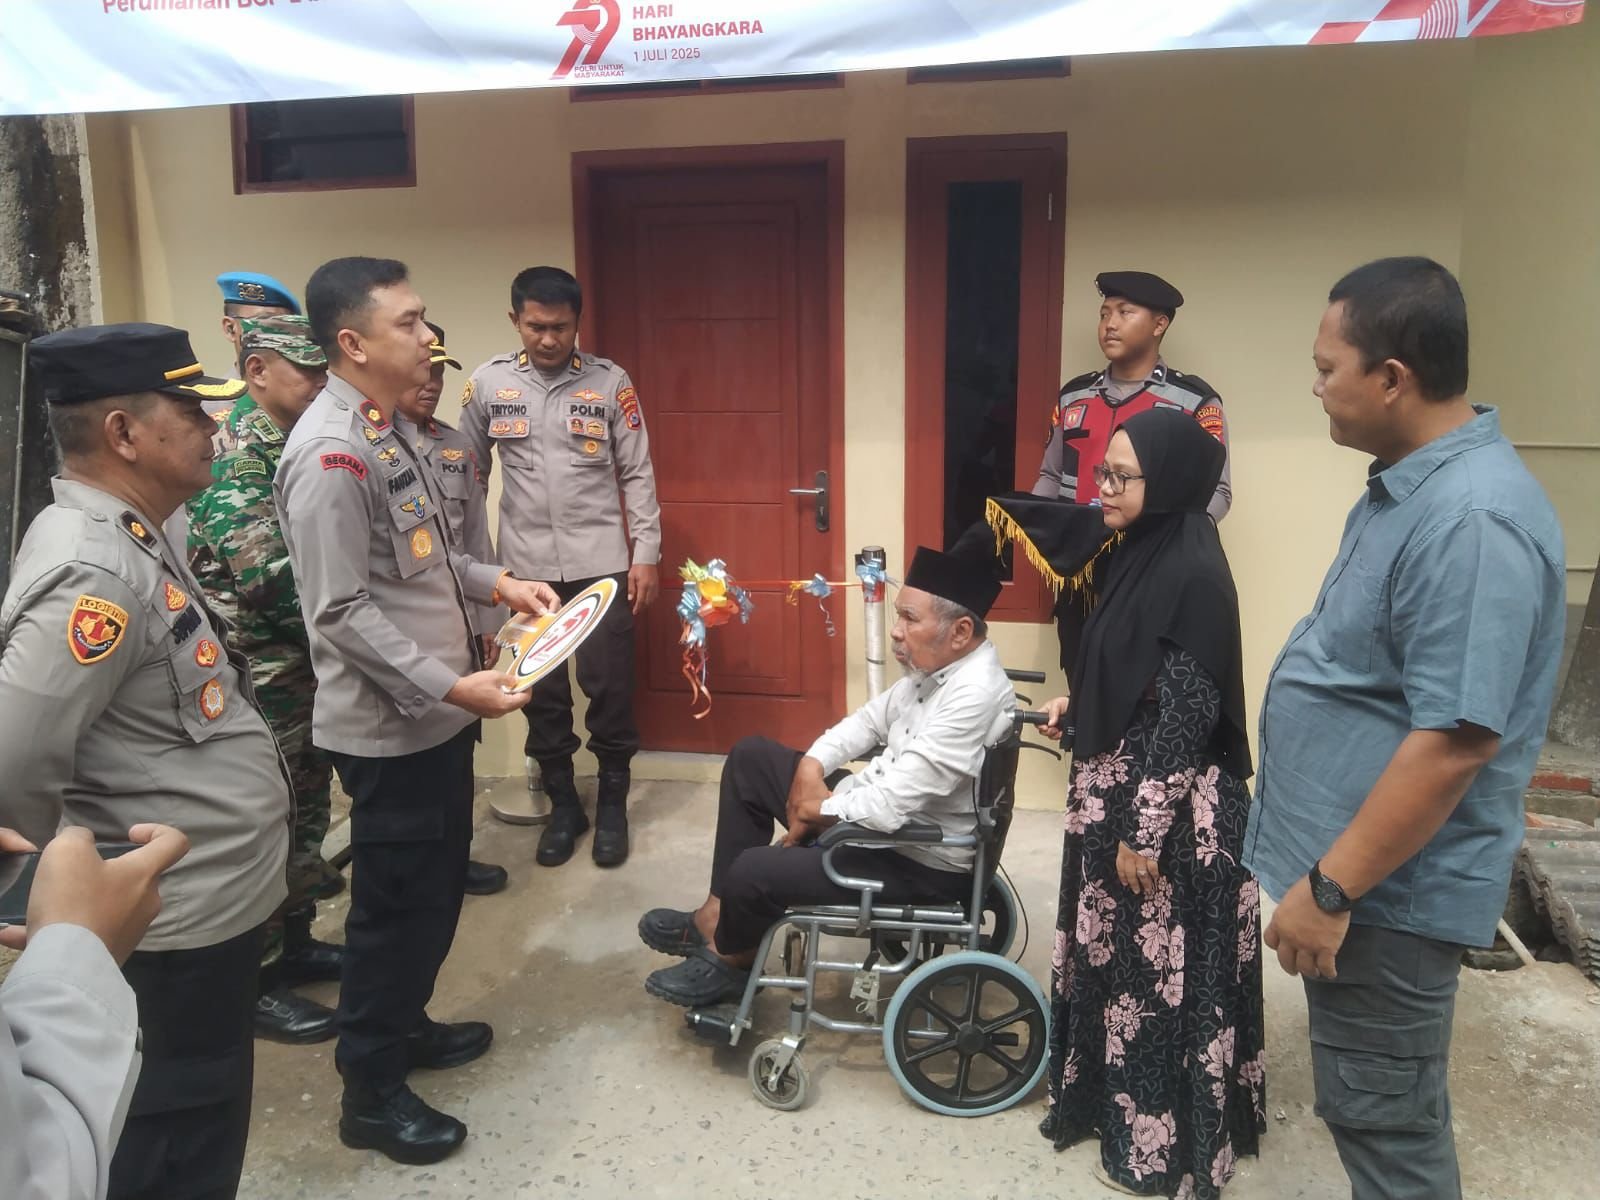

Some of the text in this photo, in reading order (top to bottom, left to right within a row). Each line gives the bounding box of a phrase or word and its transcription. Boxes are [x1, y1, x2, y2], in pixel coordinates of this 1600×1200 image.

[633, 4, 673, 20] HARI
[633, 20, 763, 41] BHAYANGKARA
[633, 48, 701, 62] 1 JULI 2025
[599, 63, 624, 71] UNTUK
[574, 70, 625, 79] MASYARAKAT
[490, 404, 527, 417] TRIYONO
[570, 404, 605, 418] POLRI
[325, 456, 364, 477] GEGANA
